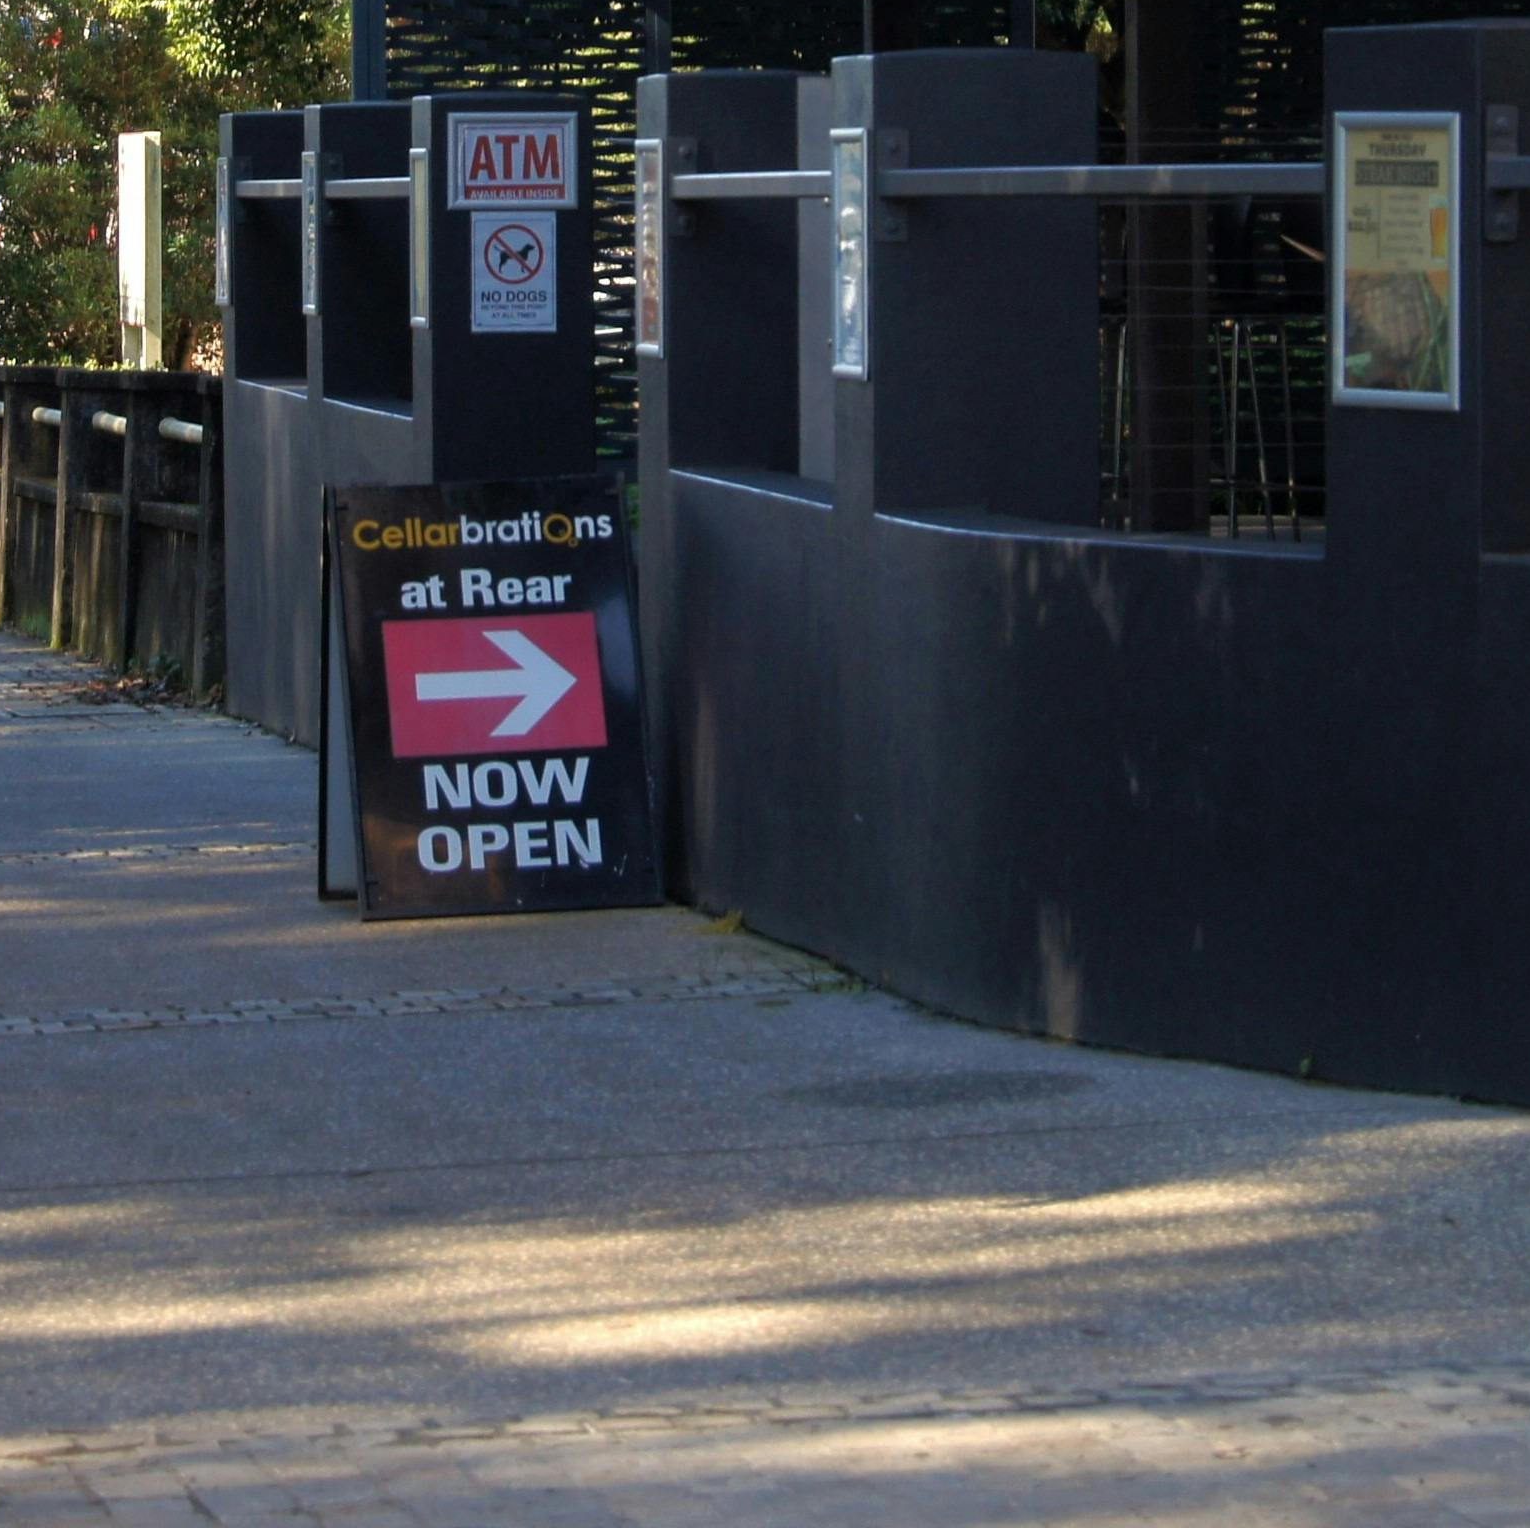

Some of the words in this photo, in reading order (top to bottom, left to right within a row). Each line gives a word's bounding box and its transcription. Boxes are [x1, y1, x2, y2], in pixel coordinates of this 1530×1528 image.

[468, 134, 561, 182] ATM
[469, 189, 525, 200] AVAILABLE
[525, 188, 560, 199] INSIDE
[480, 290, 502, 303] NO
[506, 290, 548, 303] DOGS
[400, 575, 447, 609] at
[460, 568, 572, 607] Rear
[422, 757, 590, 810] NOW
[416, 818, 603, 873] OPEN
